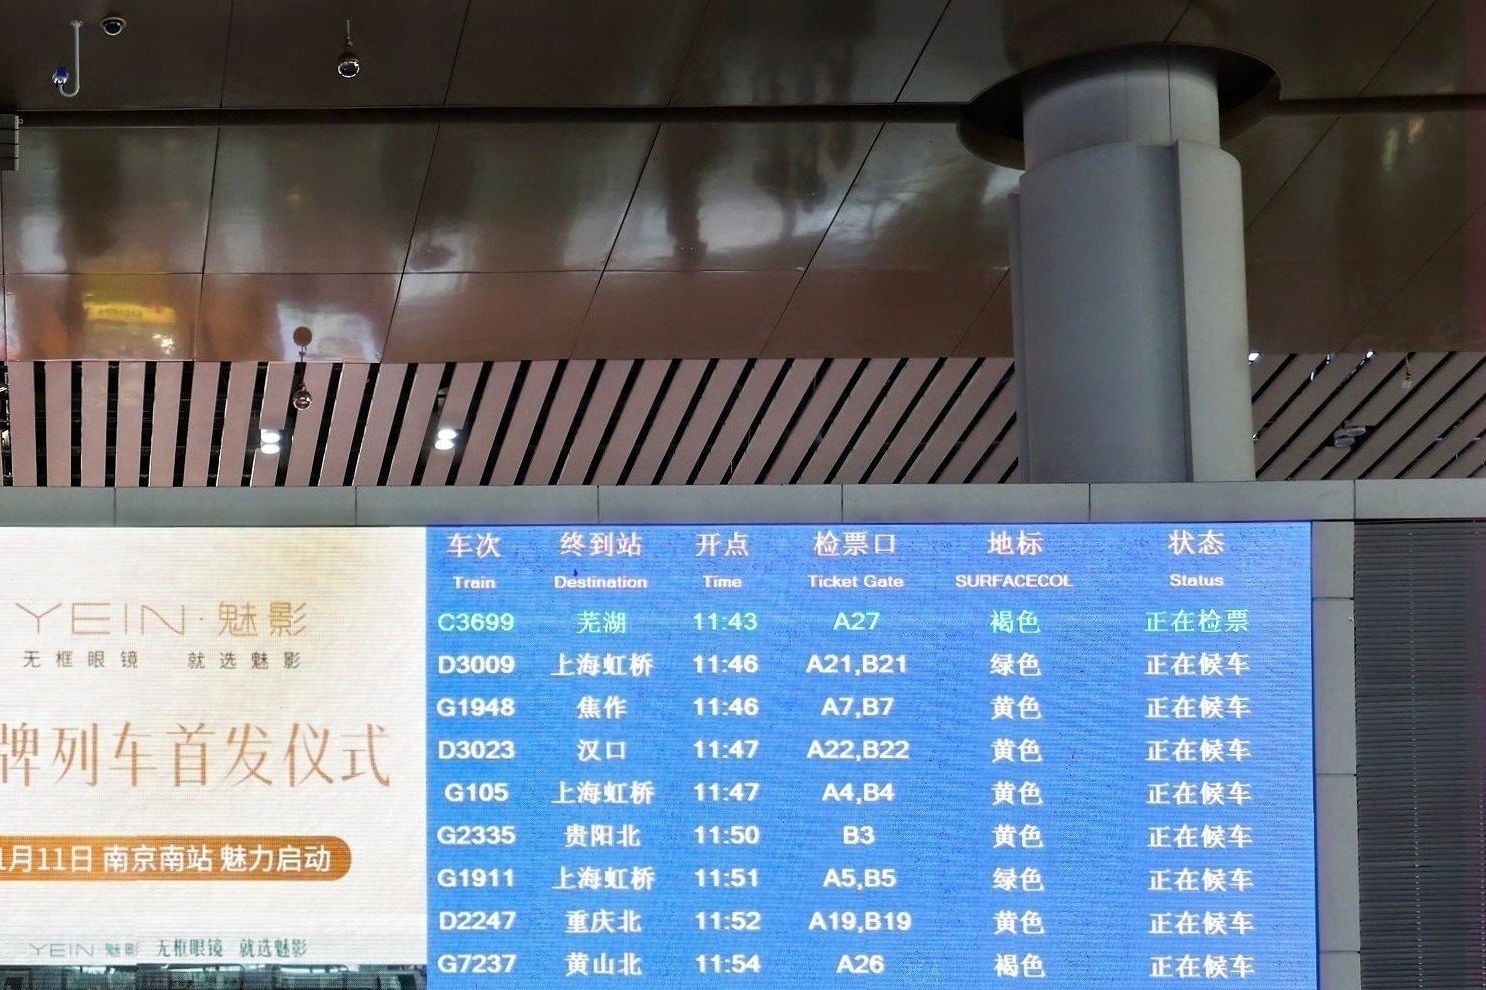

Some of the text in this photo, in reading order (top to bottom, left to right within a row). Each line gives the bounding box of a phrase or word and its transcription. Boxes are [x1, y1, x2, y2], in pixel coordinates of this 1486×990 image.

[449, 530, 1224, 558] 车次 终到站 开点 检票口 地标 状态
[454, 574, 1224, 589] Train Destination Time Ticket Gate SURFACECOL Status
[438, 611, 880, 634] C3699 芜湖 11:43 A27
[22, 650, 301, 671] 无框眼镜 就选魅影
[438, 653, 906, 677] D3009 上海虹桥 11:46 A21,B21
[436, 696, 894, 719] G1948 焦作 11:46 A7,B7
[438, 739, 909, 762] D3023 汉口 11:47 A22,B22
[444, 781, 895, 805] G105 上海虹桥 11:47 A4,B4
[437, 824, 875, 847] G2335 贵阳北 11:50 B3
[103, 844, 213, 873] 南京南站
[220, 844, 332, 873] 魅力启动
[439, 909, 912, 934] D2247 重庆北 11:52 A19,B19
[156, 938, 223, 958] 无框眼镜
[239, 938, 307, 959] 就选魅影
[437, 952, 885, 976] G7237 黄山北 11:54 A26
